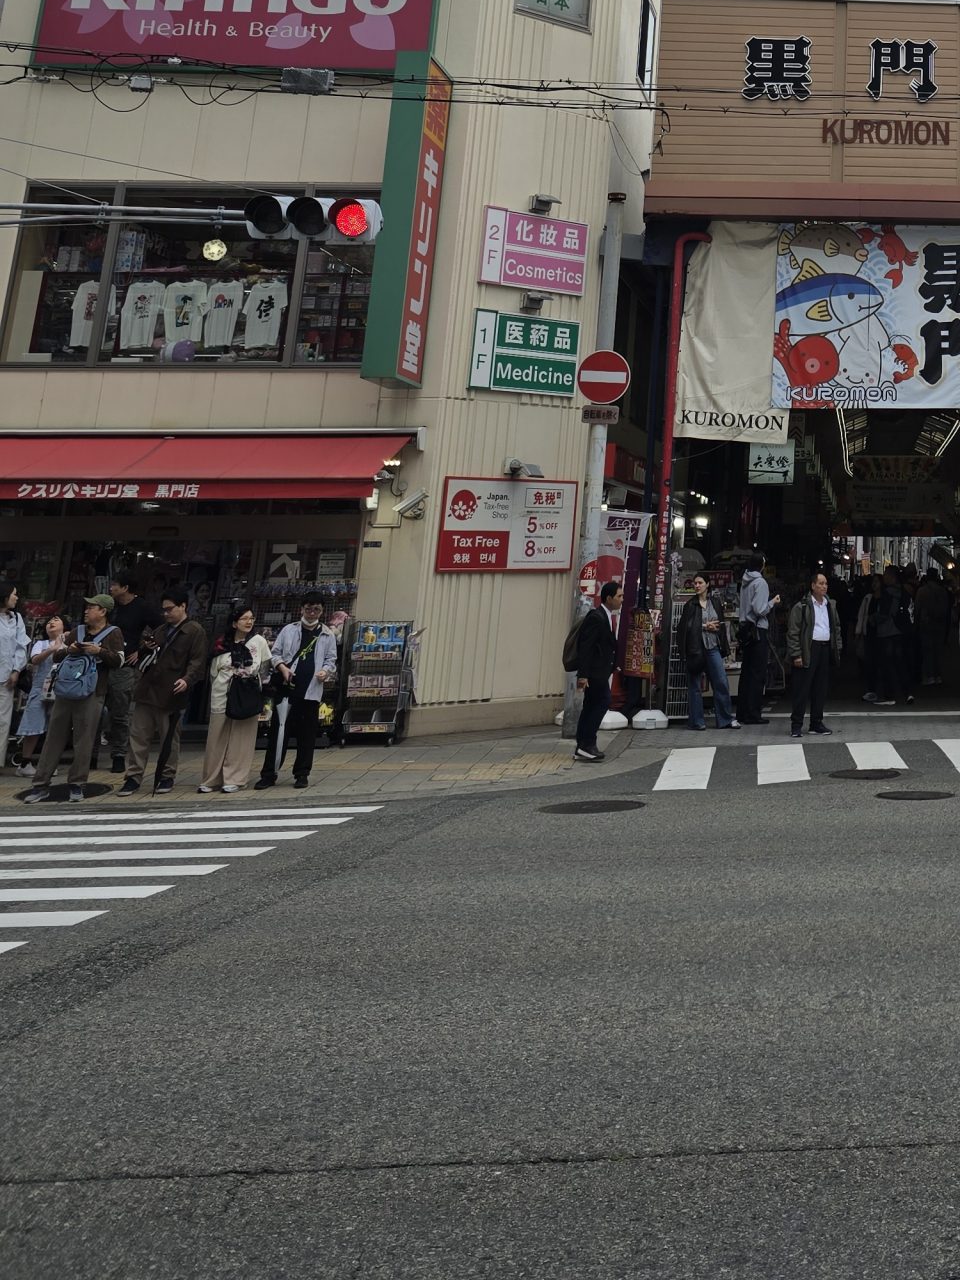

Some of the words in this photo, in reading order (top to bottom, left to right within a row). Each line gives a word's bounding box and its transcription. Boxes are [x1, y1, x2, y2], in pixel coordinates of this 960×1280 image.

[139, 19, 217, 37] Health
[225, 25, 238, 37] &
[248, 21, 333, 43] Beauty
[821, 118, 950, 146] KUROMON
[402, 148, 439, 375] キリン堂
[504, 258, 583, 286] Cosmetics
[495, 361, 573, 387] Medicine
[785, 379, 898, 402] KUROMON
[680, 408, 785, 431] KUROMON
[17, 483, 62, 498] クスリ
[80, 483, 140, 498] キリン堂
[154, 483, 201, 498] 黒門店
[486, 492, 510, 502] Japan.
[533, 491, 556, 506] 免税
[483, 502, 509, 511] Tax-free
[491, 511, 509, 520] Shop
[452, 535, 473, 547] Tax
[475, 536, 500, 548] Free
